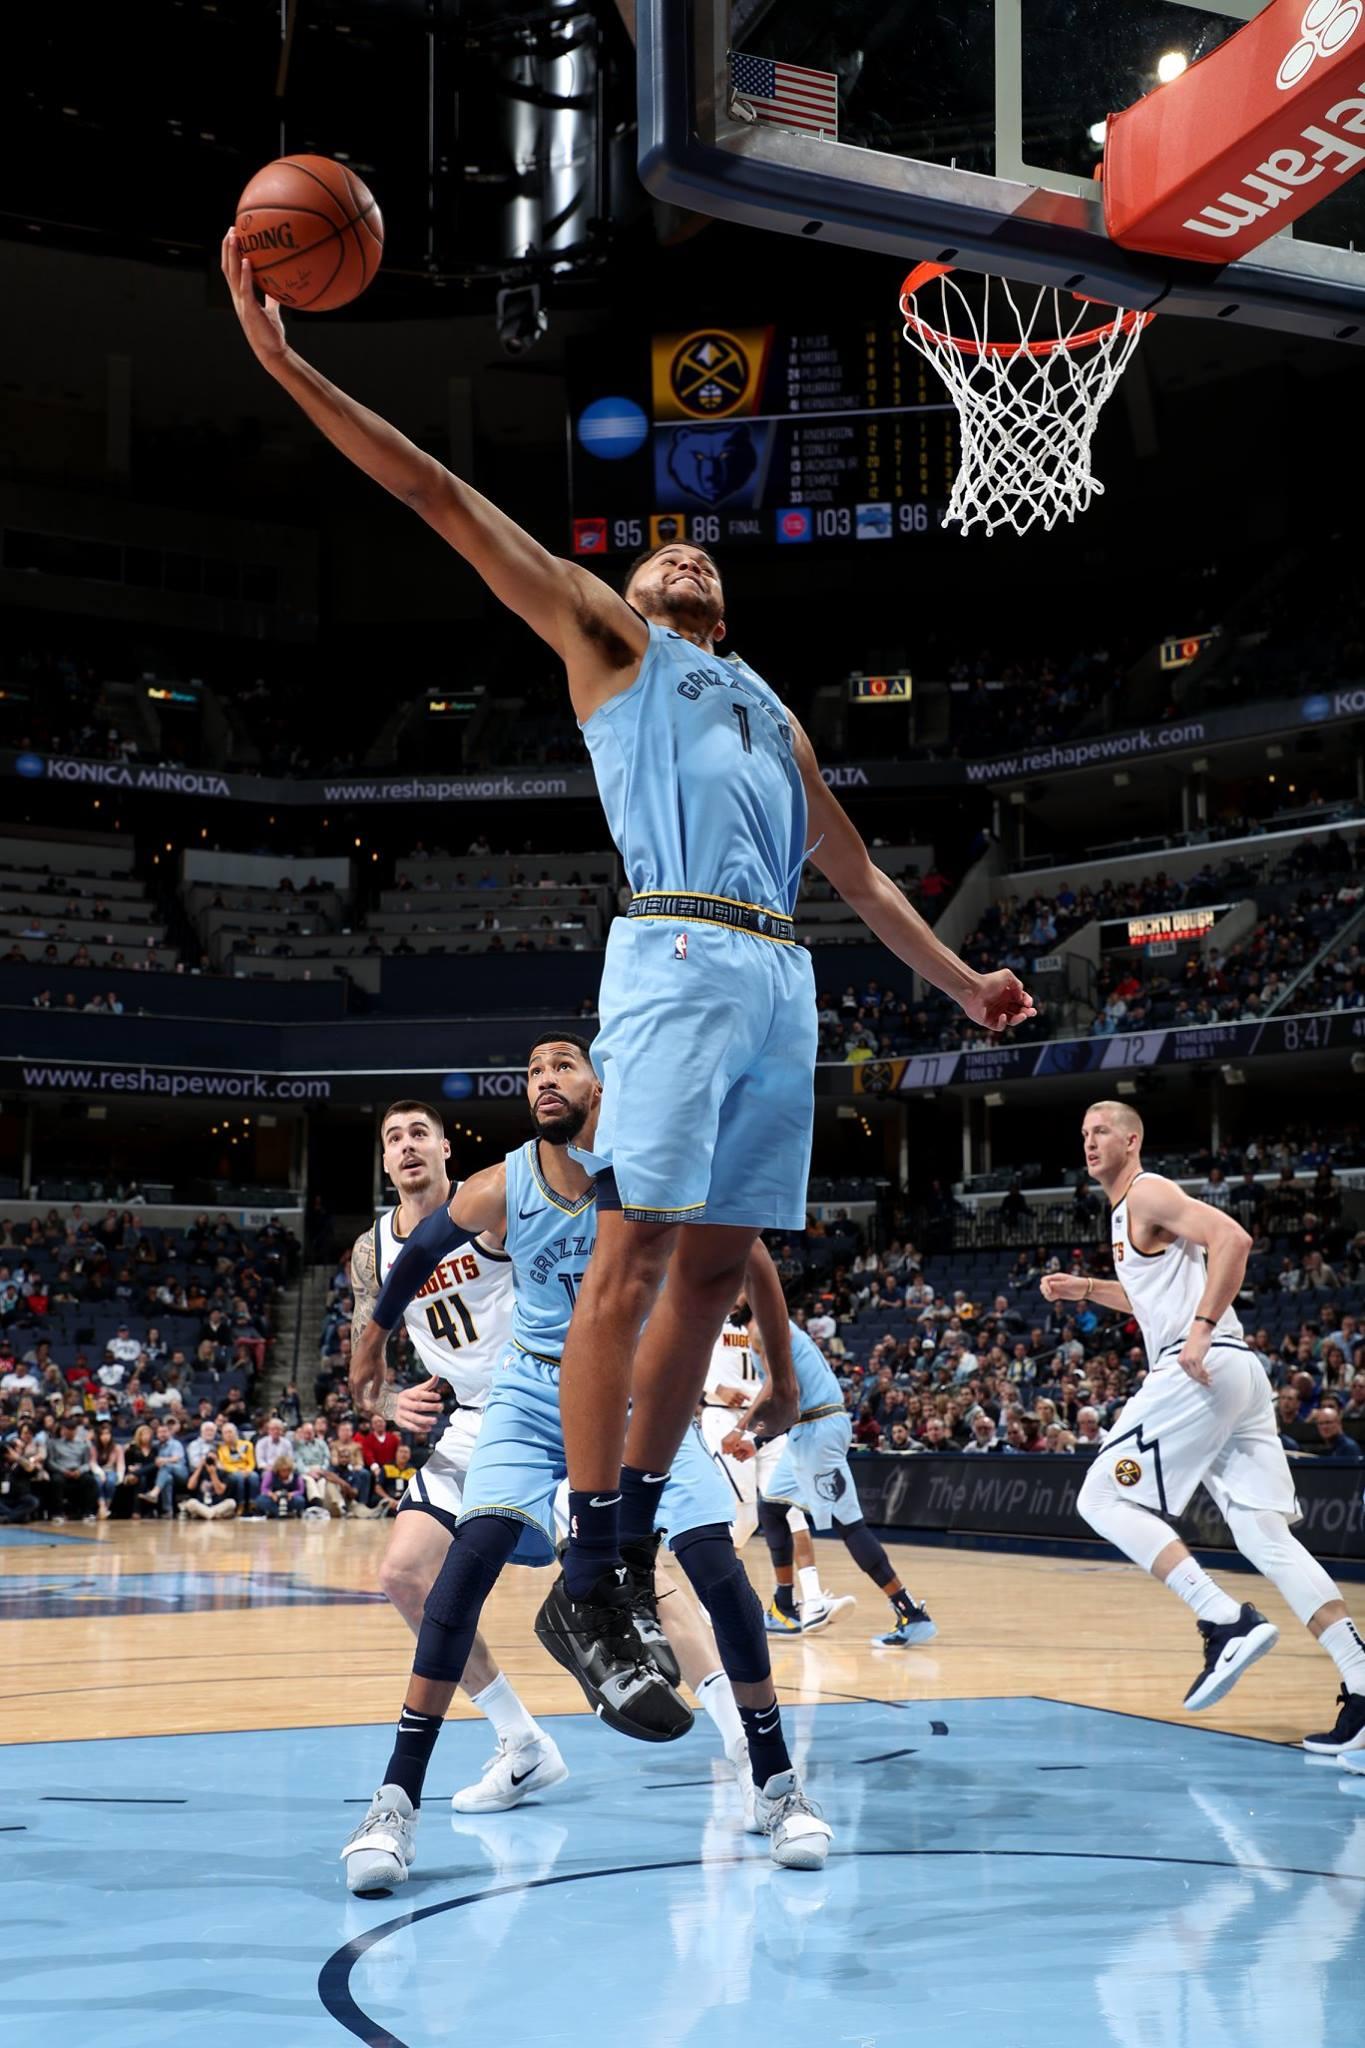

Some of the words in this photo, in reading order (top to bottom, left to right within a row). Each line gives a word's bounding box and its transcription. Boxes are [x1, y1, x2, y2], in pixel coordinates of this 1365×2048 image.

[1182, 96, 1365, 237] eFarm
[613, 519, 641, 548] 95
[691, 515, 720, 543] 86
[728, 519, 761, 536] FINAL
[816, 507, 851, 537] 103
[899, 503, 926, 533] 96
[731, 703, 752, 755] 1
[967, 722, 1205, 782] www.reshapework.com
[47, 758, 134, 787] KONICA
[137, 767, 230, 797] MINOLTA
[323, 776, 567, 801] www.reshapework.com
[1173, 910, 1214, 931] DOUGH
[1175, 1029, 1227, 1044] TIMEOUTS:
[1284, 1016, 1332, 1050] 8:47
[964, 1051, 1011, 1067] TIMEOUTS:
[1122, 1037, 1145, 1066] 72
[22, 1065, 331, 1097] www.reshapework.com
[919, 1059, 940, 1084] 77
[425, 1293, 478, 1350] 41
[930, 1477, 966, 1511] The
[970, 1479, 1028, 1513] MVP
[1029, 1480, 1053, 1515] in
